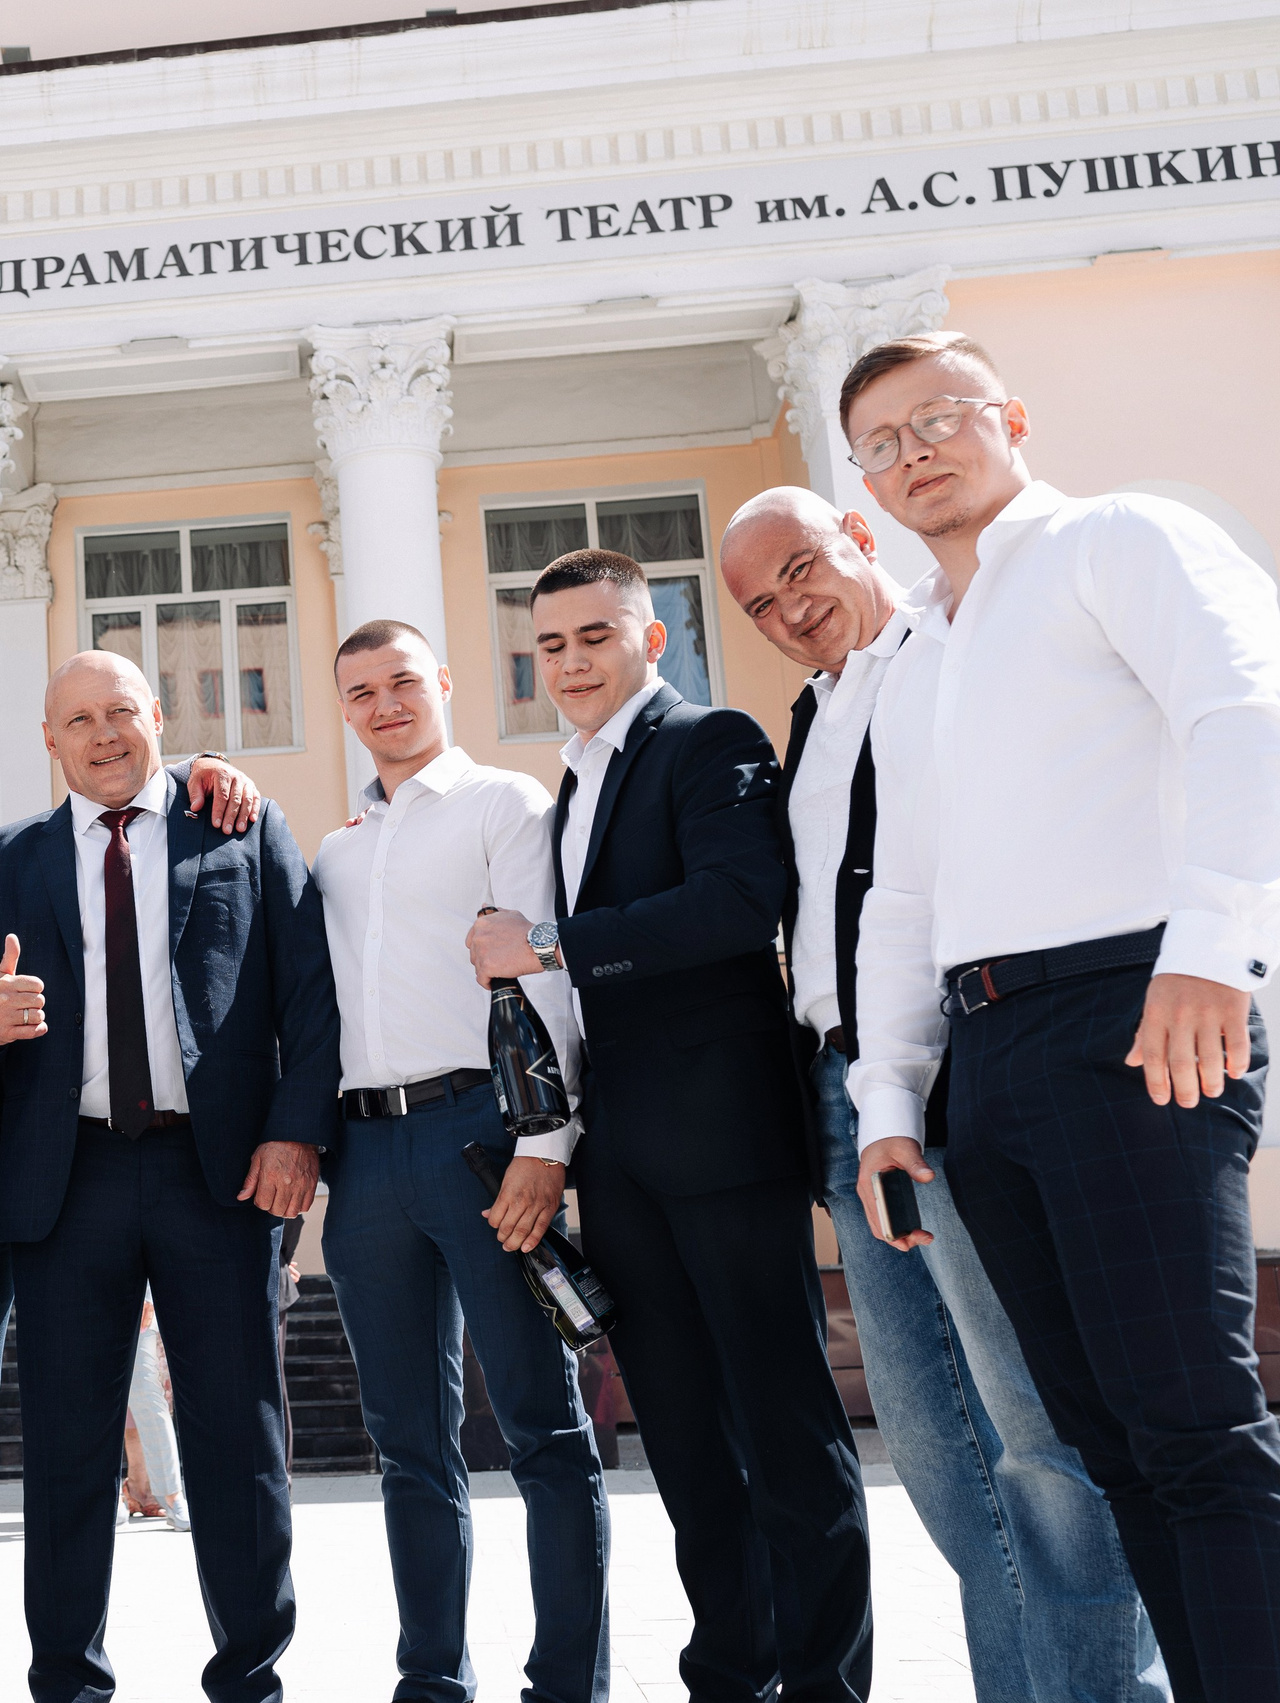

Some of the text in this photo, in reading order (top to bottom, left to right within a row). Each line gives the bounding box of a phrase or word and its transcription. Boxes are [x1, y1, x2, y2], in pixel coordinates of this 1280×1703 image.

[545, 193, 733, 242] ТЕАТР
[755, 194, 846, 224] им.
[861, 171, 976, 214] А.С.
[989, 140, 1280, 202] ПУШКИН
